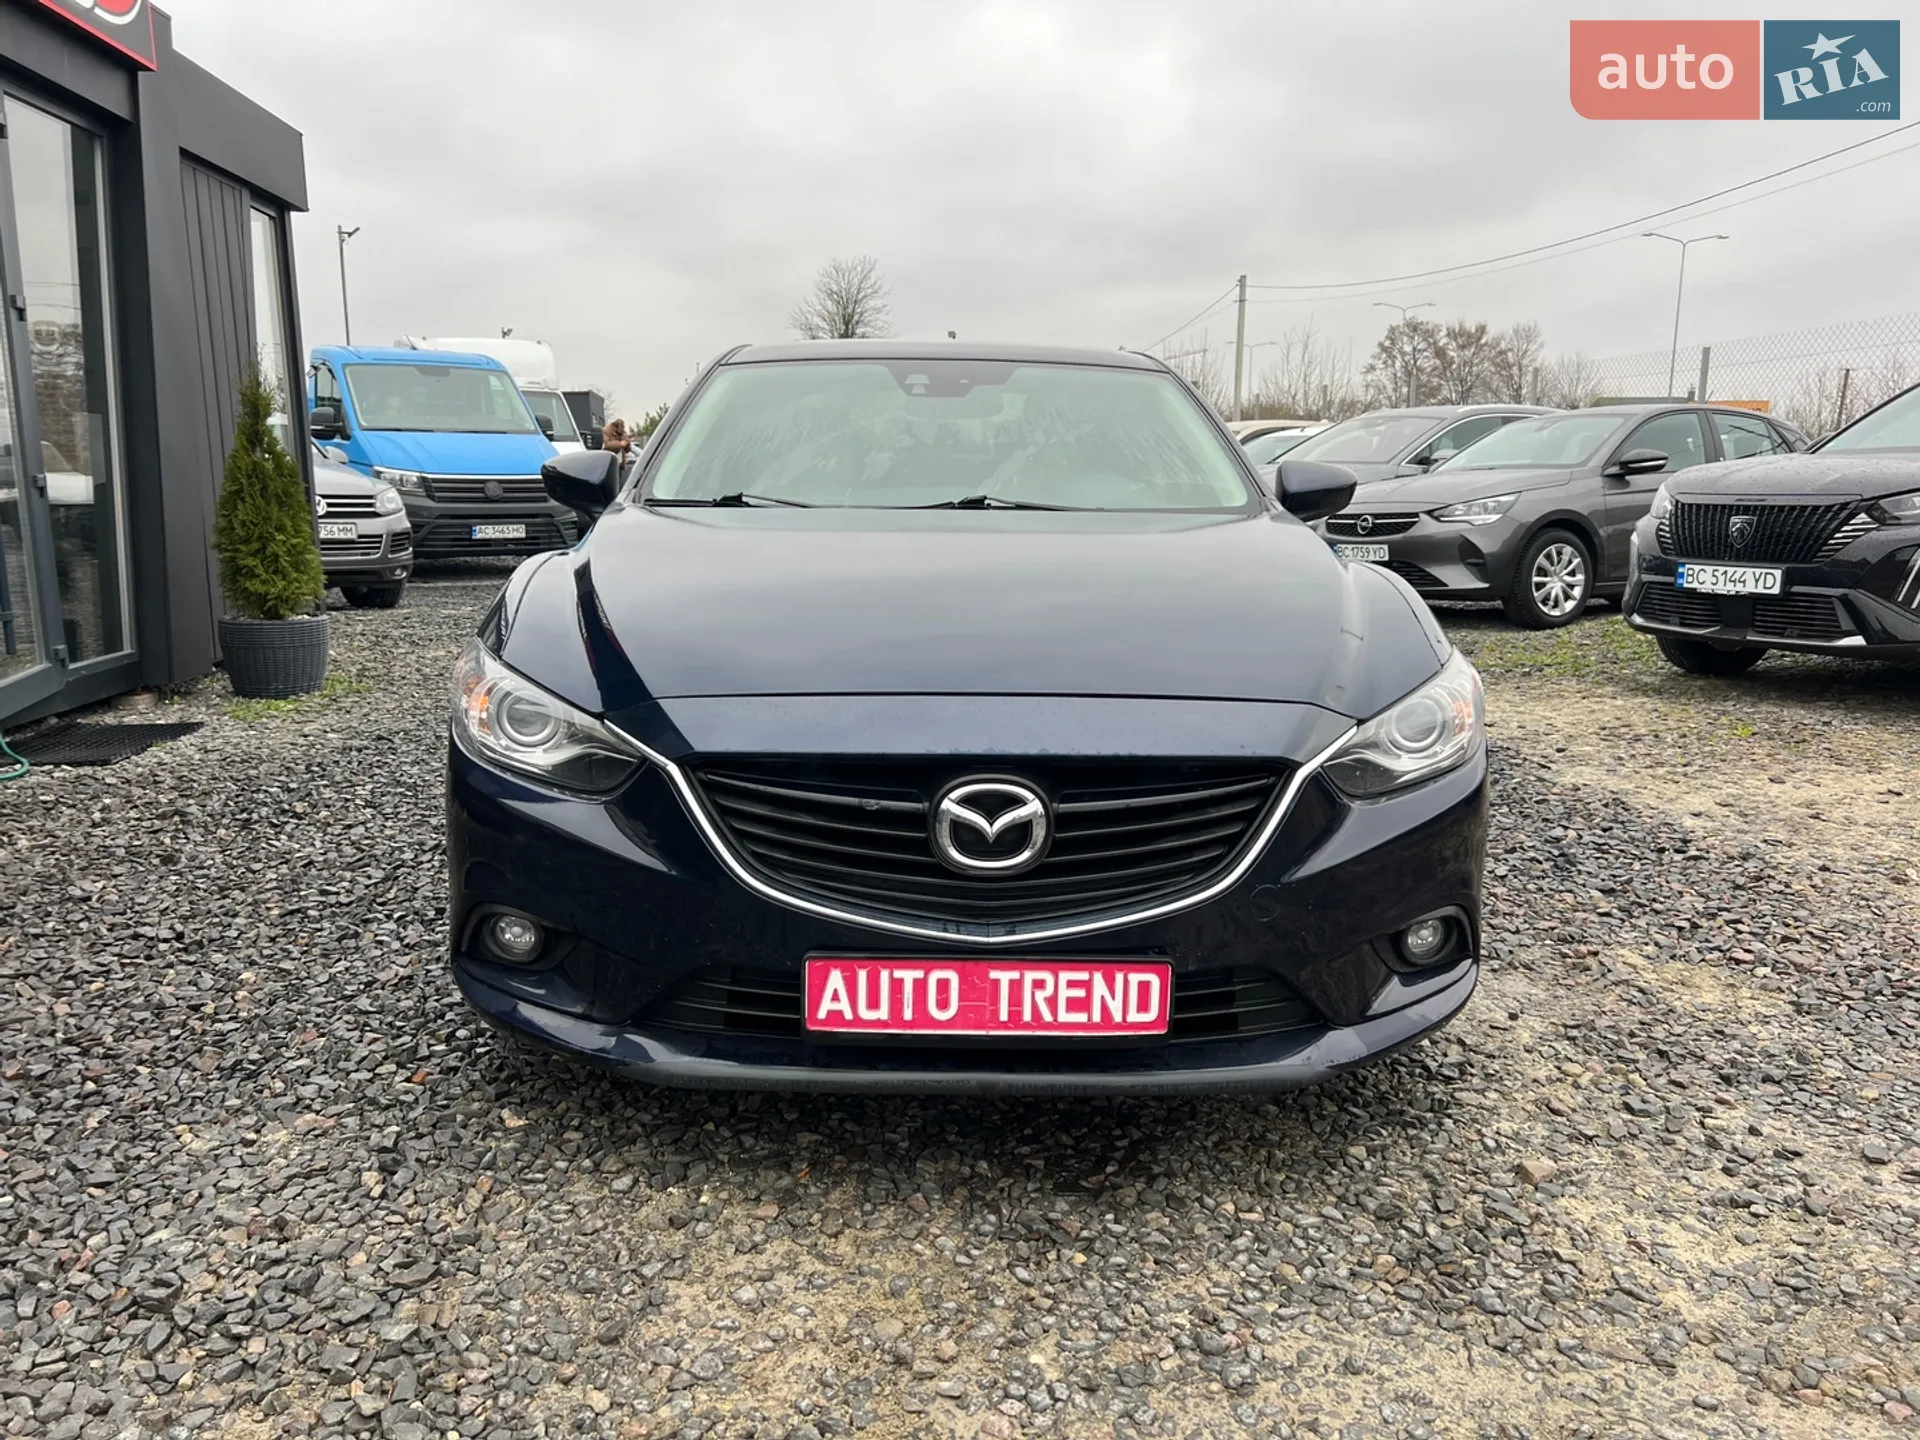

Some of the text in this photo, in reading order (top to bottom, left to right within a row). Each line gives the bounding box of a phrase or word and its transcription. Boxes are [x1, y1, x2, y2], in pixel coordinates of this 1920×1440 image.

[337, 525, 354, 537] MM
[478, 526, 490, 536] AC
[1350, 546, 1370, 559] 1759
[1371, 546, 1387, 560] YD
[1685, 567, 1777, 590] BC 5144 YD
[816, 967, 1162, 1024] AUTO TREND
